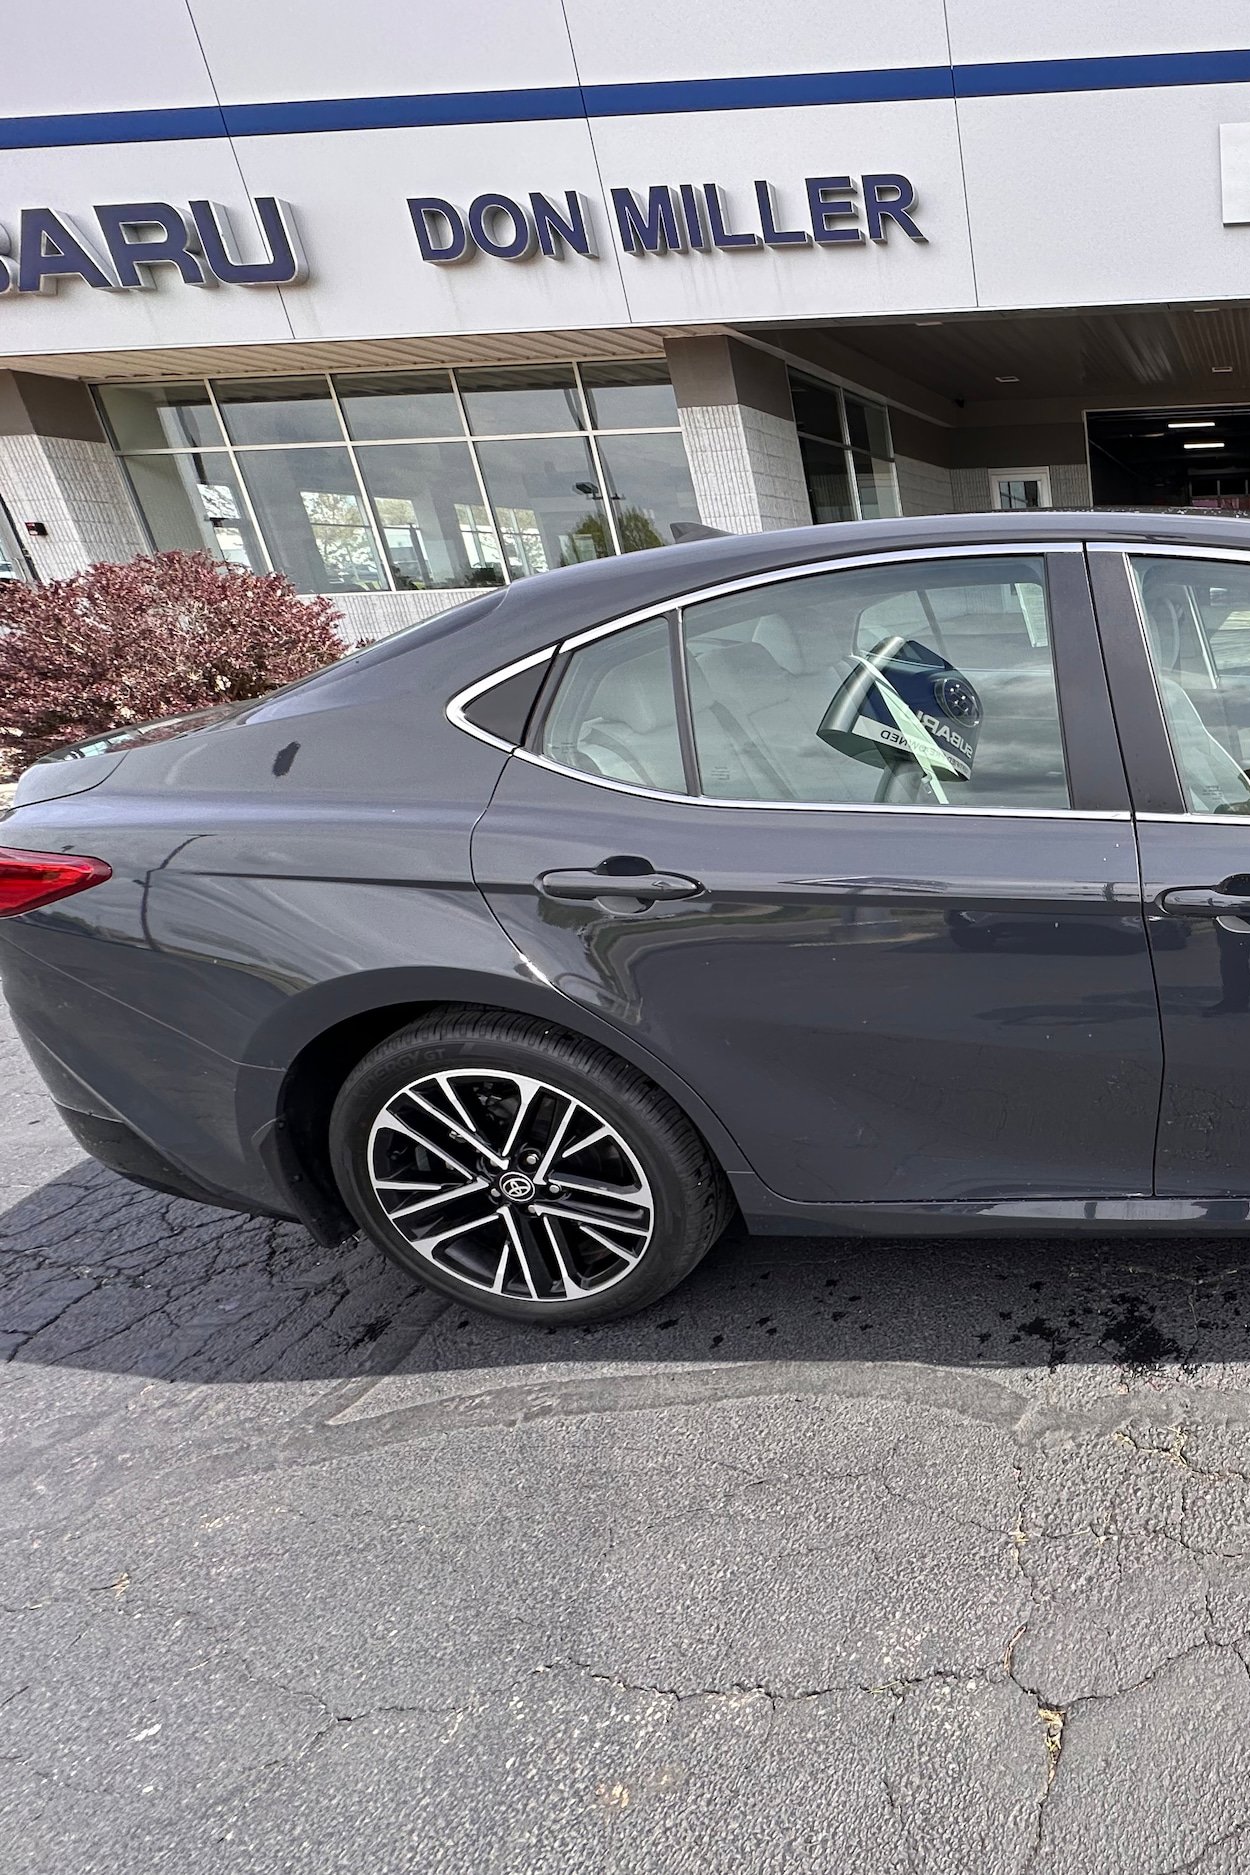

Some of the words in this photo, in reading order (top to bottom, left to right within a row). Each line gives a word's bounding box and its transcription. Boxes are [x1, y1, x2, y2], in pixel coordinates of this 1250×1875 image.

[0, 196, 302, 294] ARU
[406, 190, 595, 263] DON
[610, 173, 928, 255] MILLER
